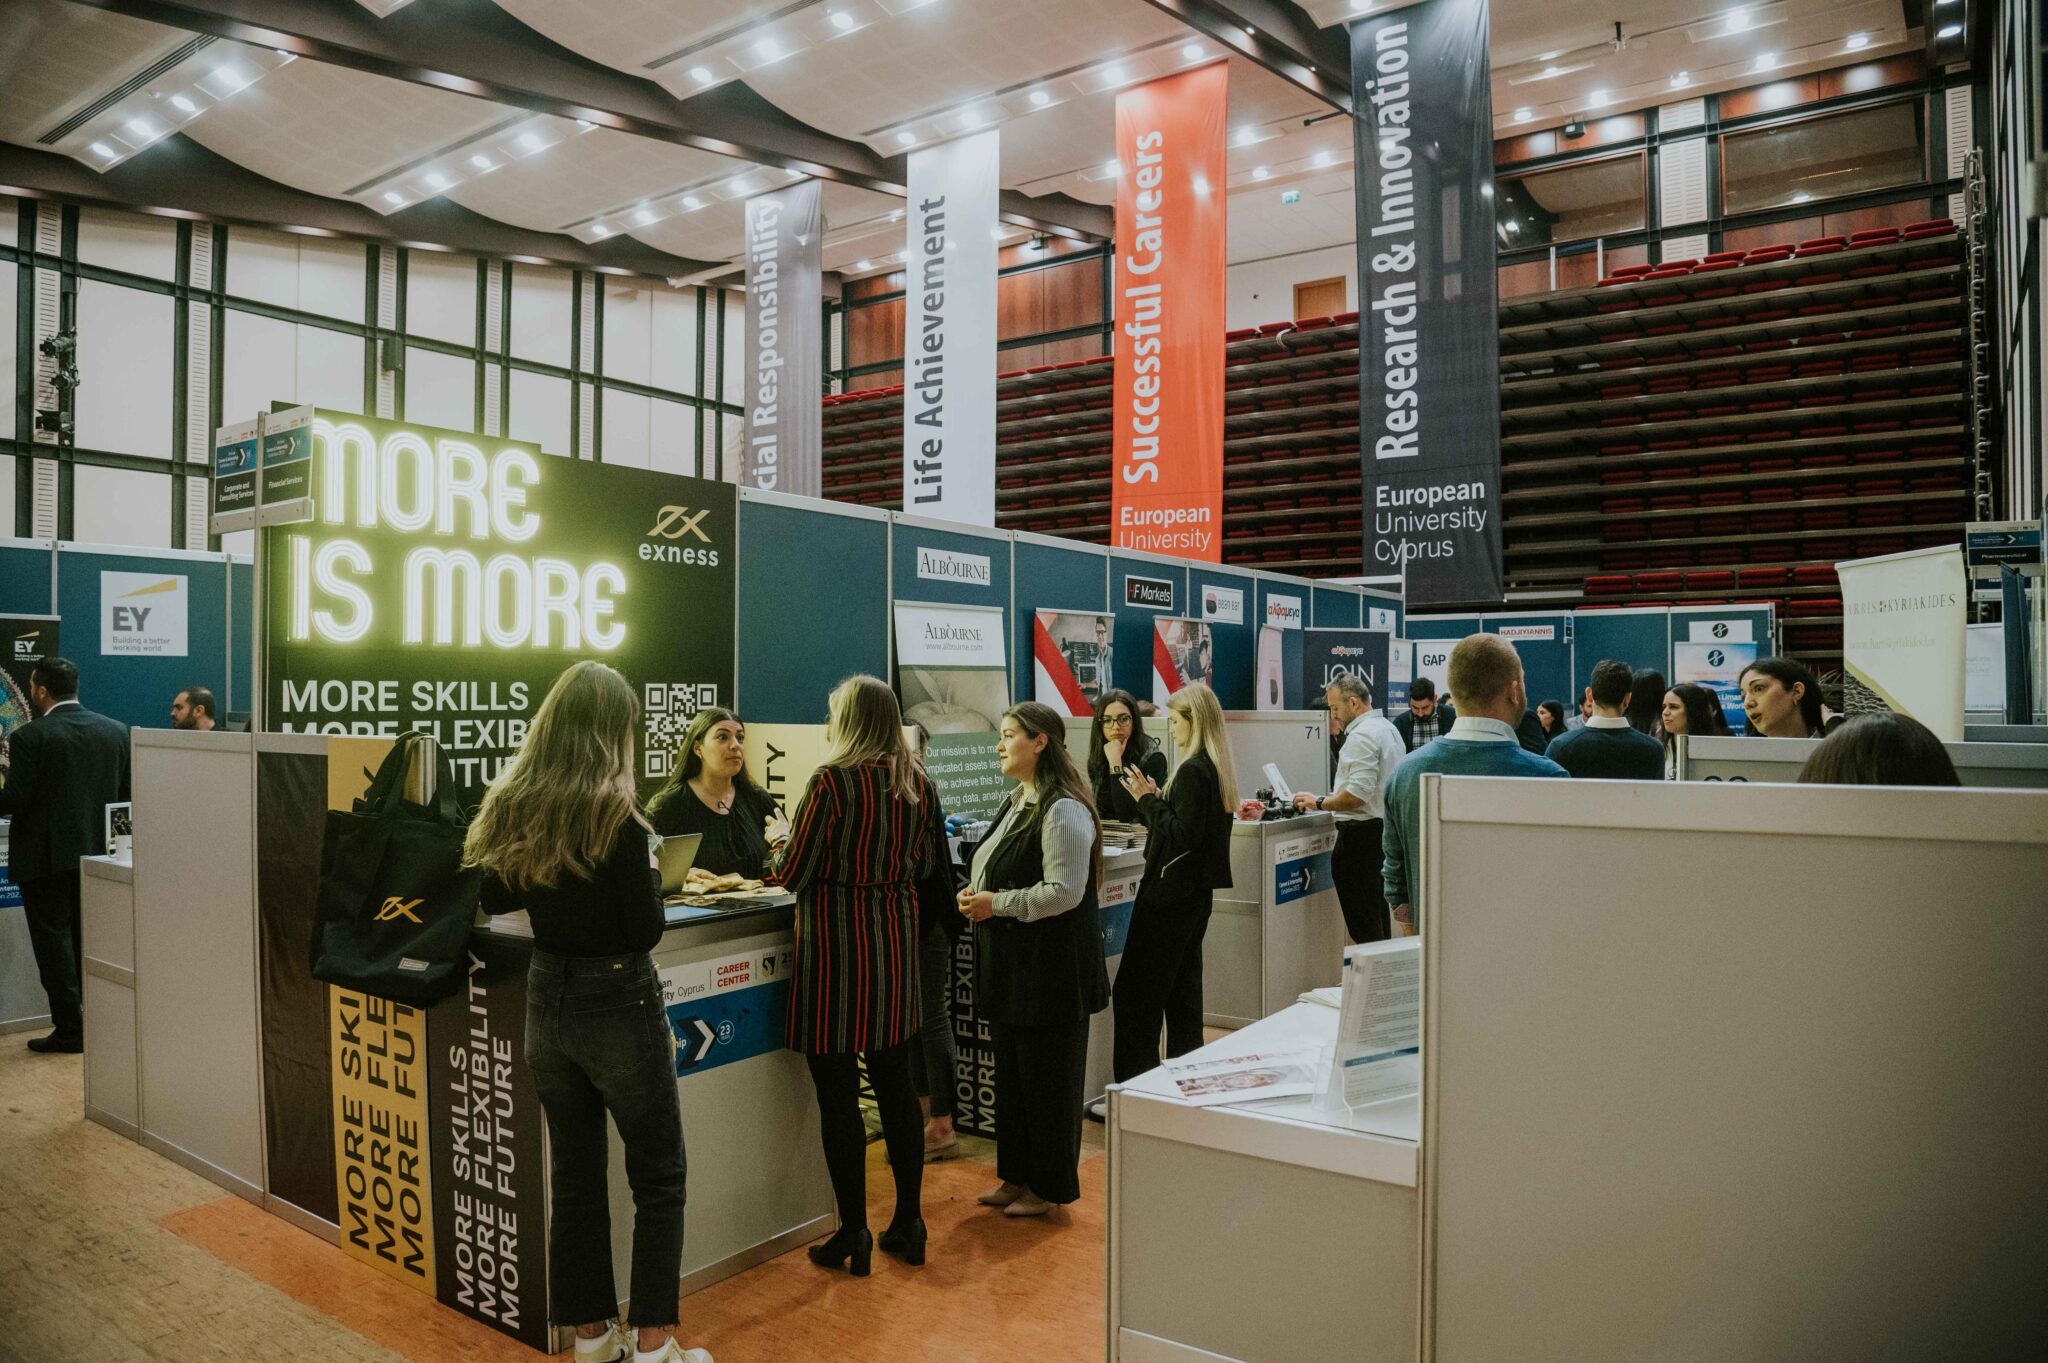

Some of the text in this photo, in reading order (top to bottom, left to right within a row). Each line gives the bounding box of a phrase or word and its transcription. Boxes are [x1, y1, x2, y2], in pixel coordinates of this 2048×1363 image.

[1364, 21, 1419, 460] Research & Innovation
[752, 199, 784, 428] Responsibility
[1123, 130, 1163, 484] Successful Careers
[914, 195, 946, 504] Life Achievement
[312, 417, 540, 543] MORE
[1376, 481, 1485, 510] European
[1121, 506, 1210, 529] European
[1375, 504, 1487, 539] University
[638, 542, 719, 568] exness
[1120, 528, 1211, 553] University
[1375, 535, 1454, 566] Cyprus
[288, 534, 627, 651] IS MORE
[1140, 585, 1171, 603] Markets
[112, 606, 152, 632] EY
[14, 640, 36, 653] EY
[112, 635, 142, 645] Building
[149, 636, 171, 645] better
[1422, 654, 1447, 666] GAP
[282, 679, 529, 713] MORE SKILLS
[1304, 726, 1321, 740] 71
[925, 747, 939, 758] Our
[940, 746, 970, 756] mission
[970, 745, 978, 755] is
[978, 745, 986, 754] to
[964, 760, 988, 771] assets
[950, 777, 979, 789] achieve
[979, 776, 993, 786] this
[994, 775, 1005, 786] by
[716, 961, 750, 976] CAREER
[716, 973, 750, 988] CENTER
[677, 984, 705, 998] Cyprus
[719, 1024, 731, 1036] 23
[956, 1045, 974, 1128] MORE
[978, 1050, 996, 1133] MORE
[467, 950, 497, 1319] MORE FLEXIBILITY
[342, 1094, 370, 1250] MORE
[369, 1104, 397, 1264] MORE
[449, 1043, 474, 1308] MORE SKILLS
[493, 1036, 520, 1329] MORE FUTURE
[396, 1119, 426, 1278] MORE
